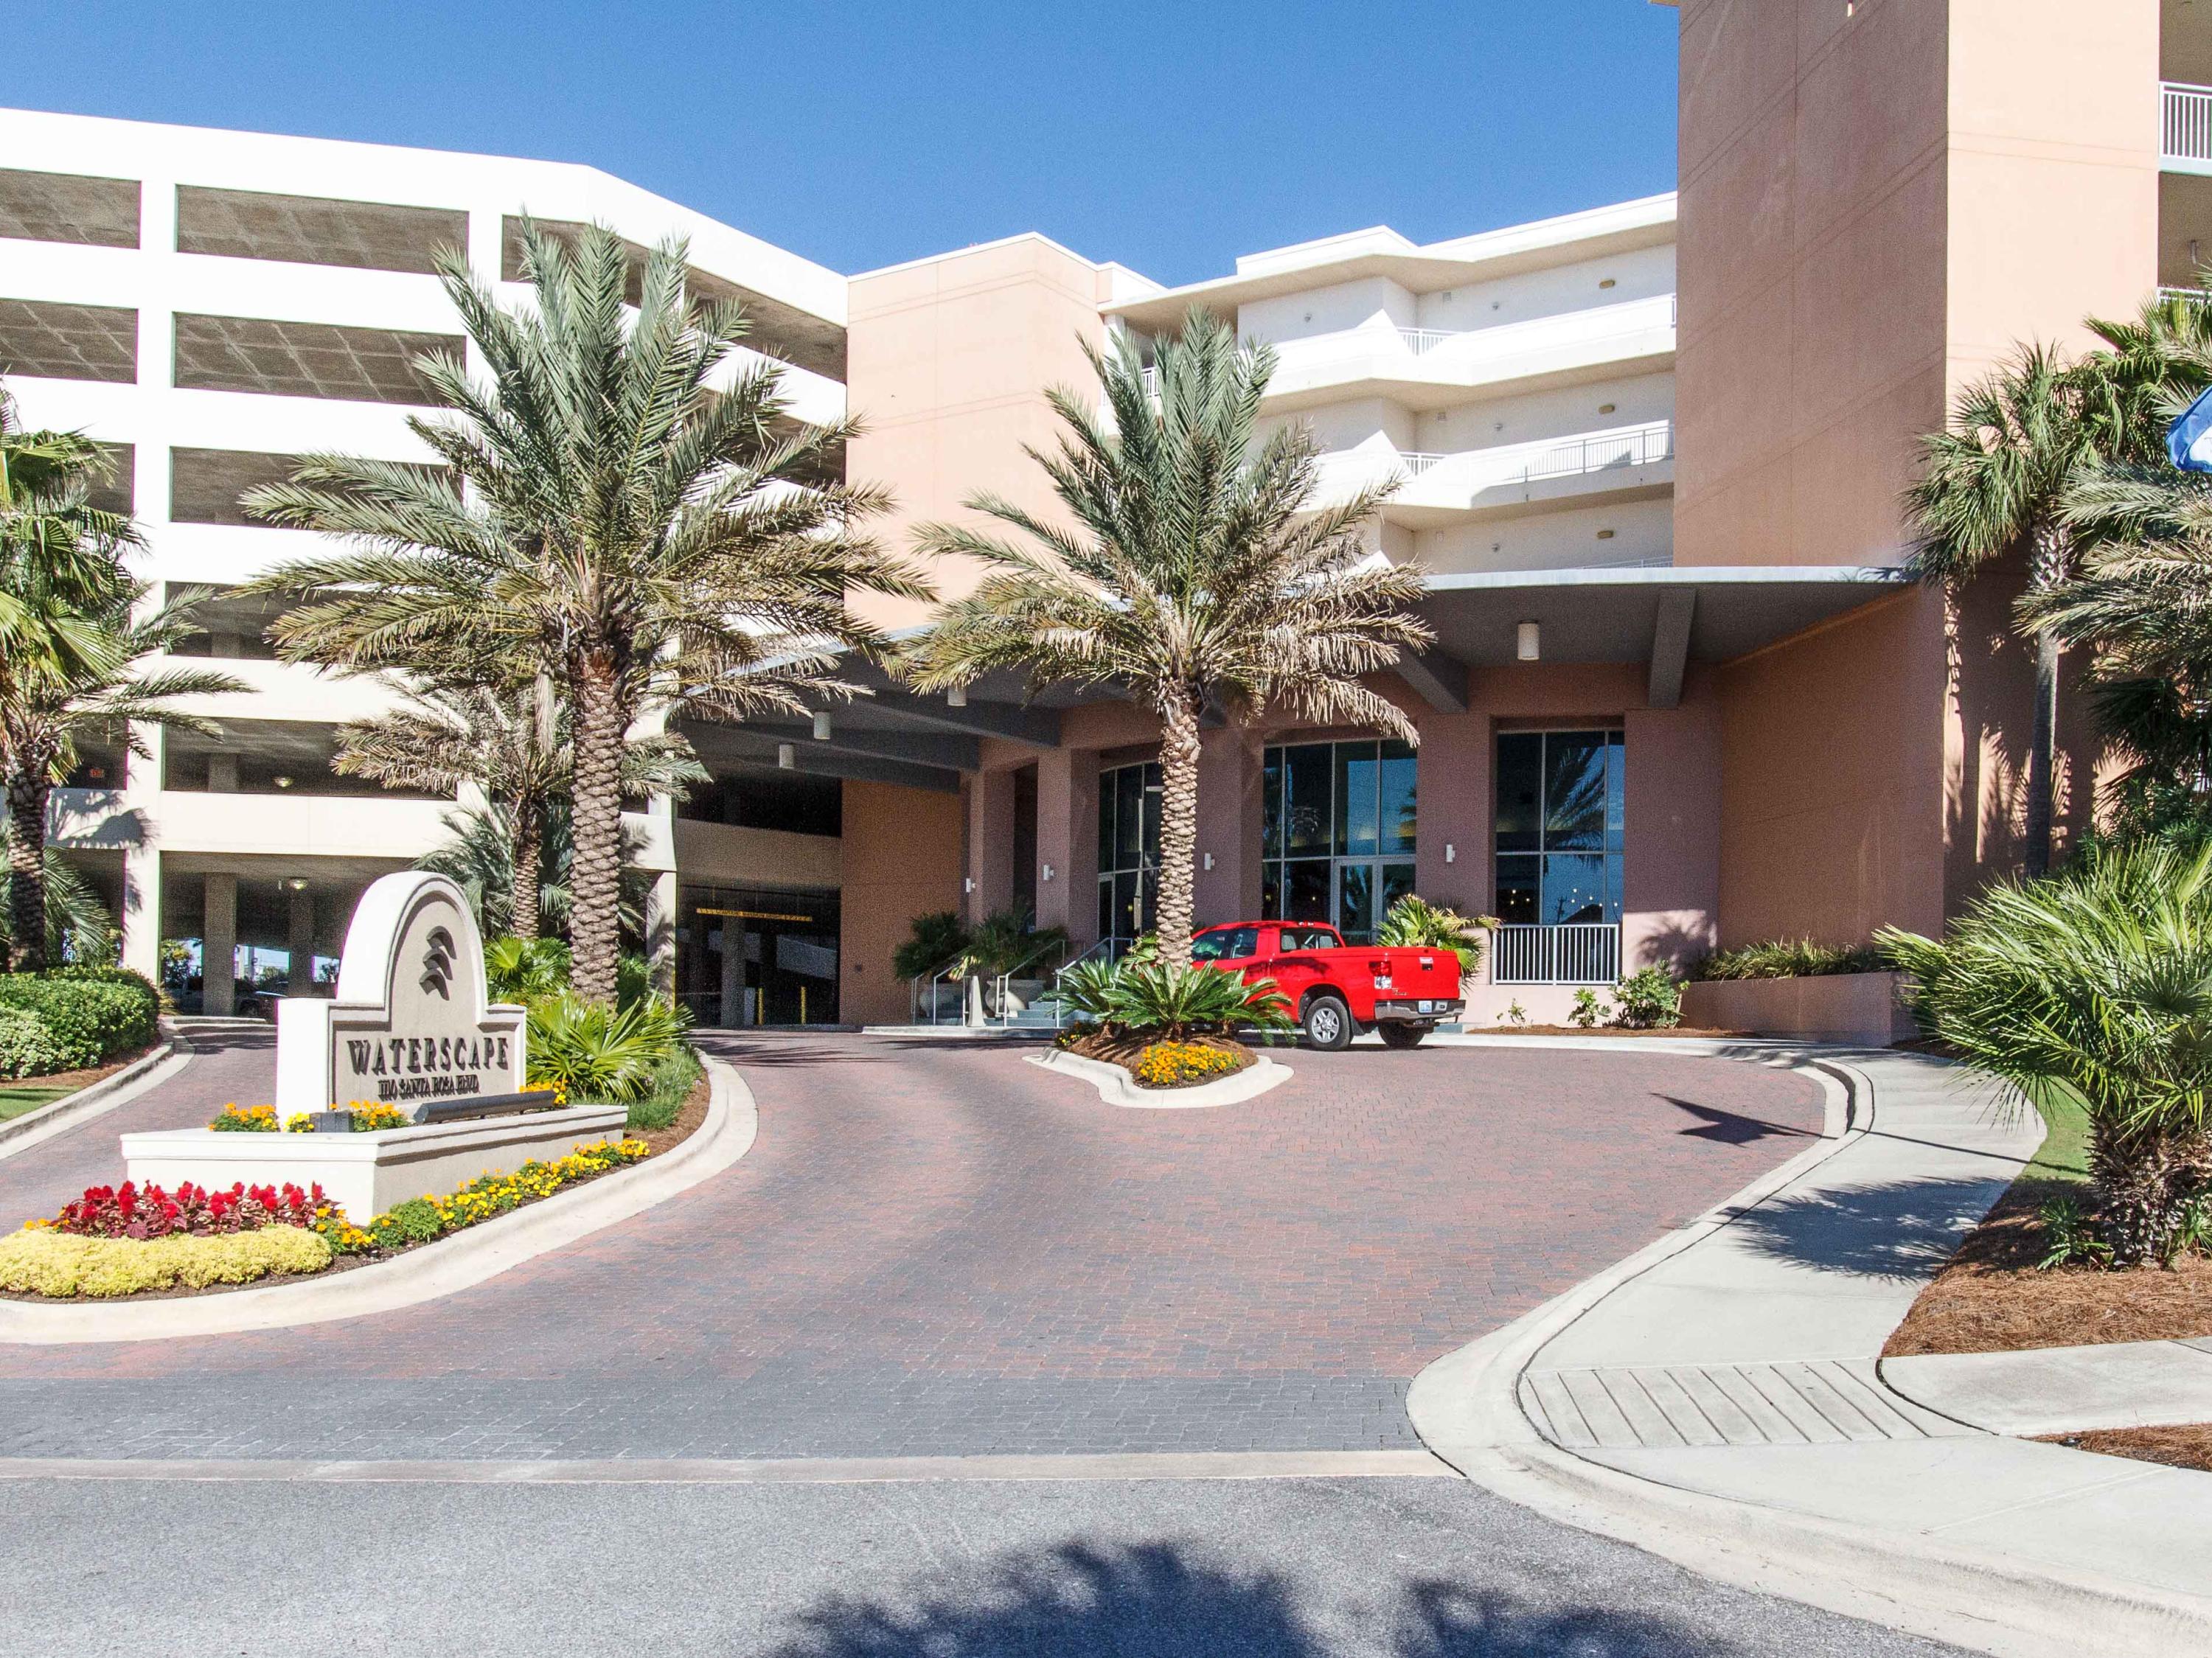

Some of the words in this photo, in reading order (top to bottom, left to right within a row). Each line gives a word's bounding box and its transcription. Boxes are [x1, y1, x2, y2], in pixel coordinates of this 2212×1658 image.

[347, 1037, 509, 1076] WATERSCAPE
[399, 1077, 431, 1099] SANTA
[431, 1076, 455, 1097] ROSA
